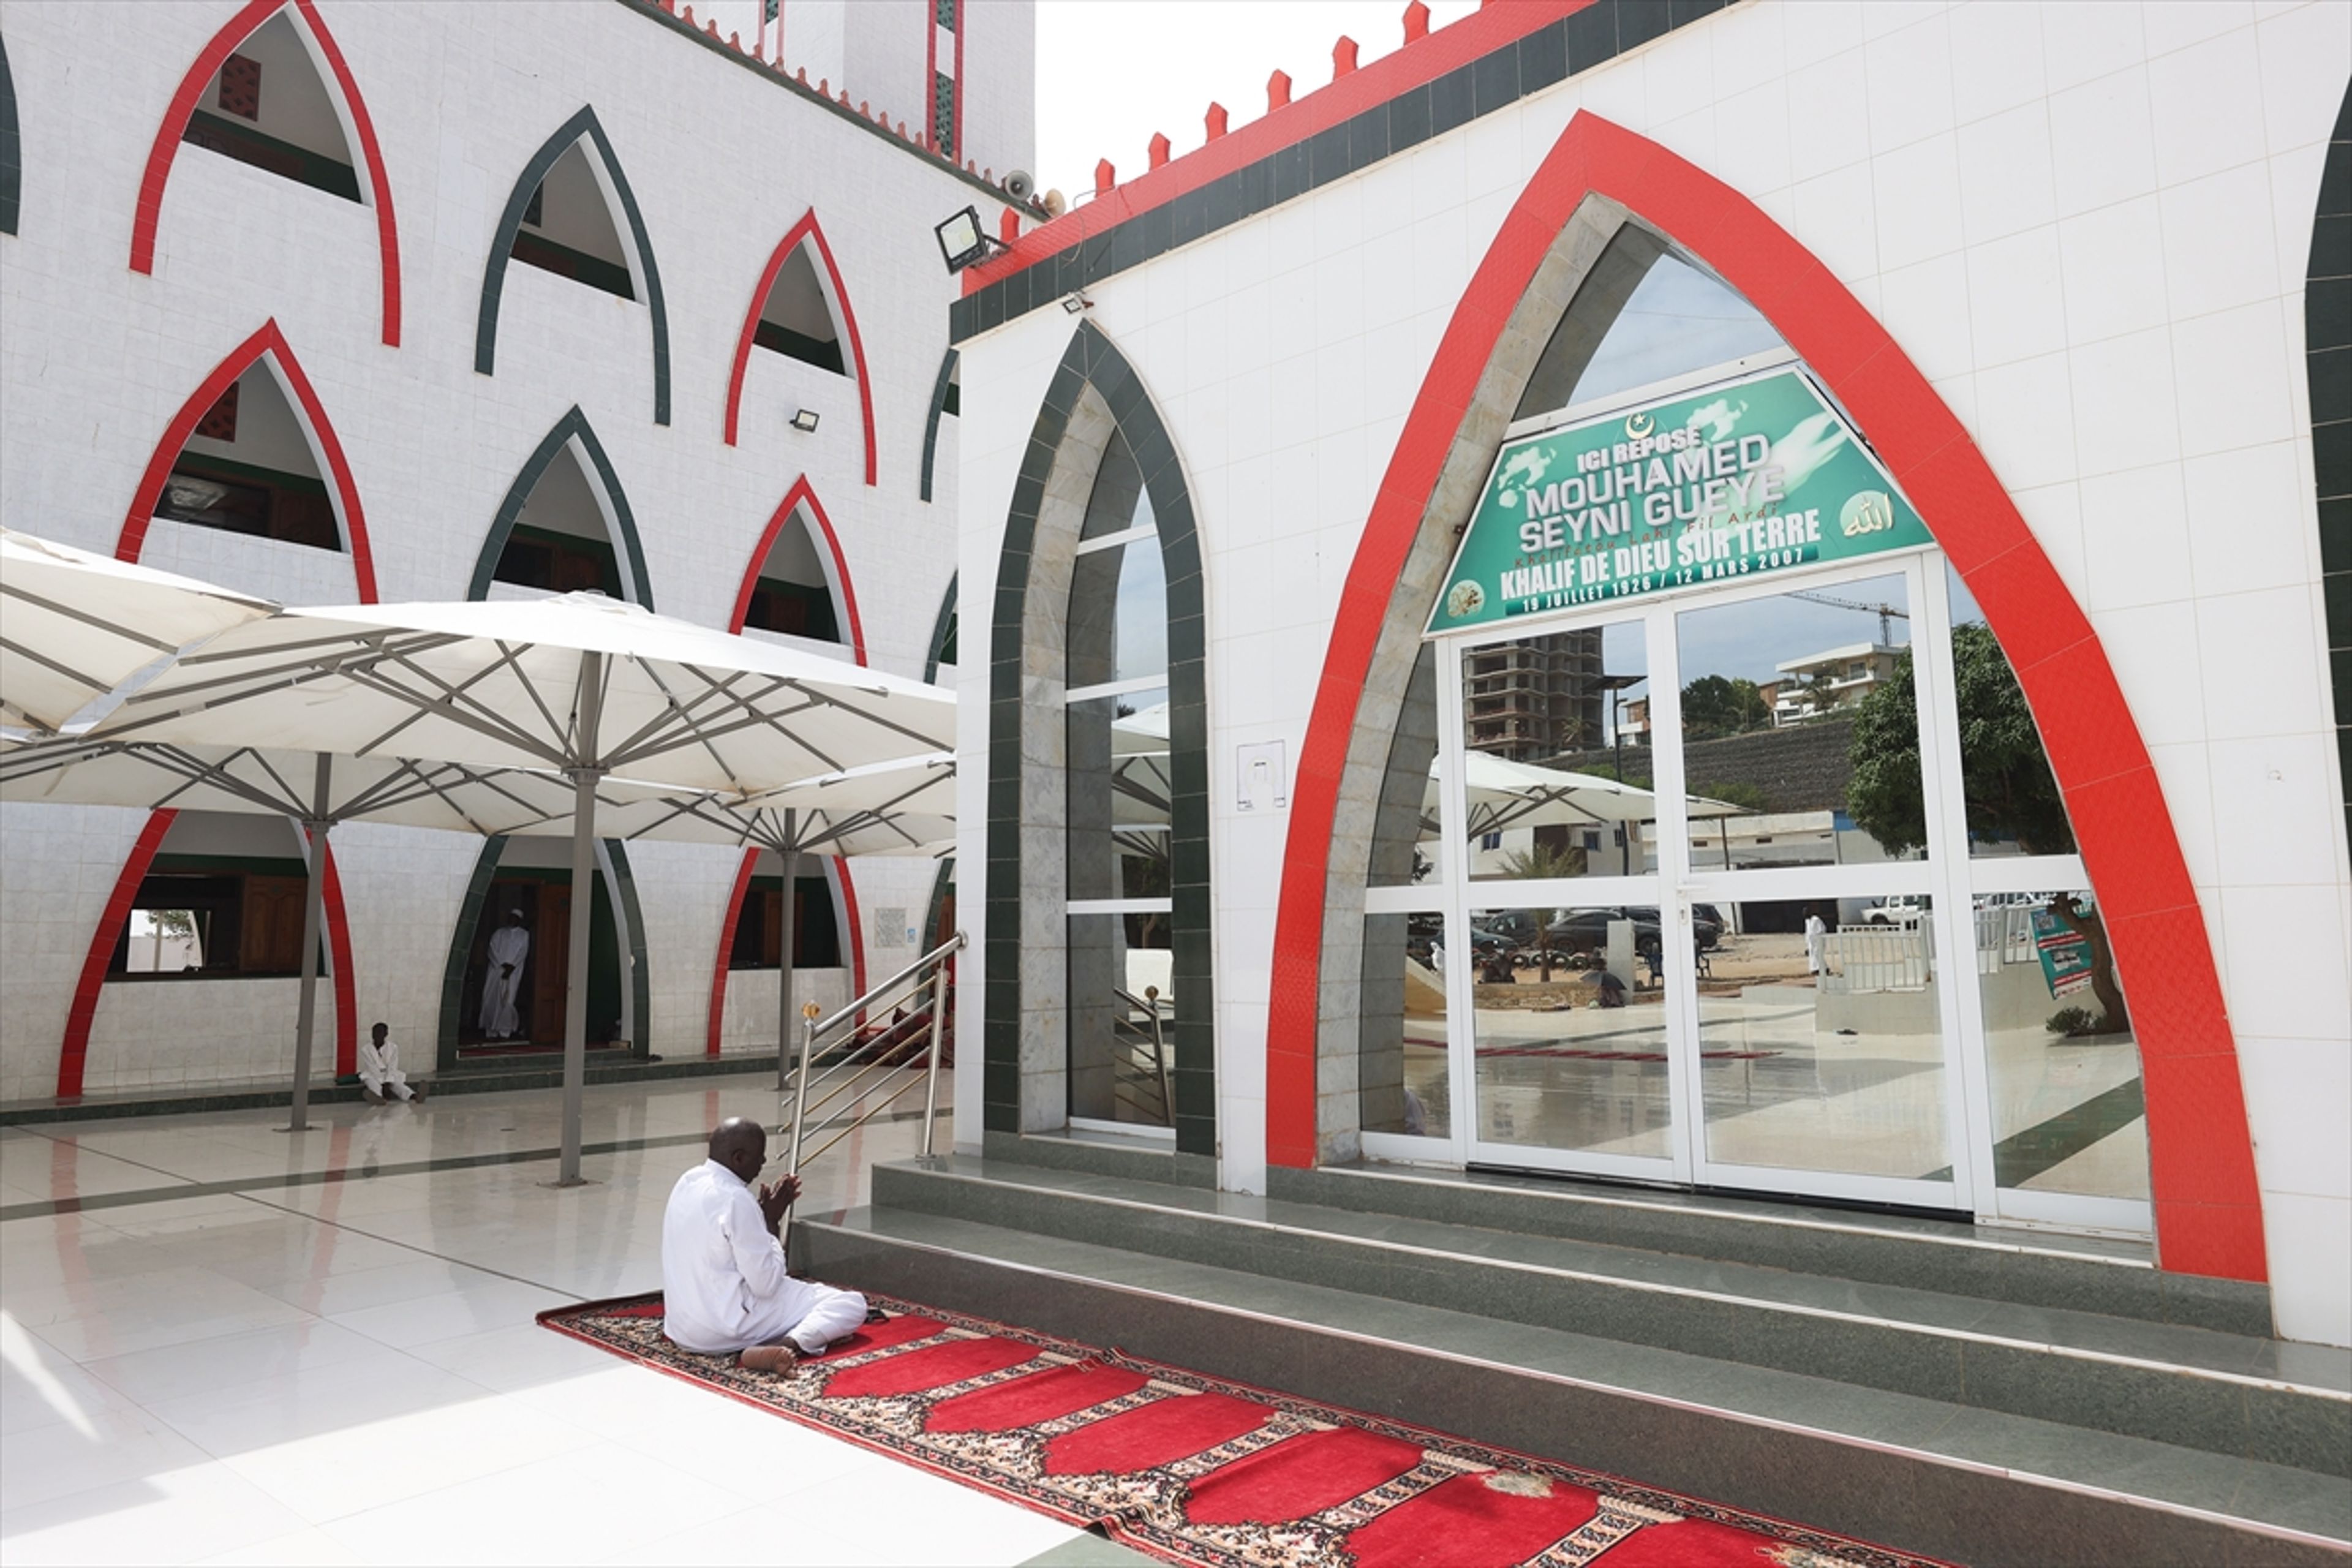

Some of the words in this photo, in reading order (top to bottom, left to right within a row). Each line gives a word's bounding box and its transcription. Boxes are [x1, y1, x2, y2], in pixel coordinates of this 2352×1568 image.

[1527, 434, 1770, 519] MOUHAMED
[1577, 448, 1610, 473] ICI
[1613, 424, 1701, 464] REPOSE
[1520, 500, 1630, 552] SEYNI
[1644, 466, 1784, 526] GUEYE
[1501, 557, 1575, 600] KHALIF
[1580, 551, 1610, 586] DE
[1615, 538, 1671, 579] DIEU
[1676, 527, 1730, 567] SUR
[1735, 508, 1822, 556] TERRE
[1523, 597, 1539, 612] 19
[1547, 584, 1604, 608] JUILLET
[1612, 576, 1651, 597] 1926
[1659, 573, 1666, 588] /
[1676, 568, 1692, 585] 12
[1702, 557, 1749, 580] MARS
[1758, 547, 1802, 570] 2007
